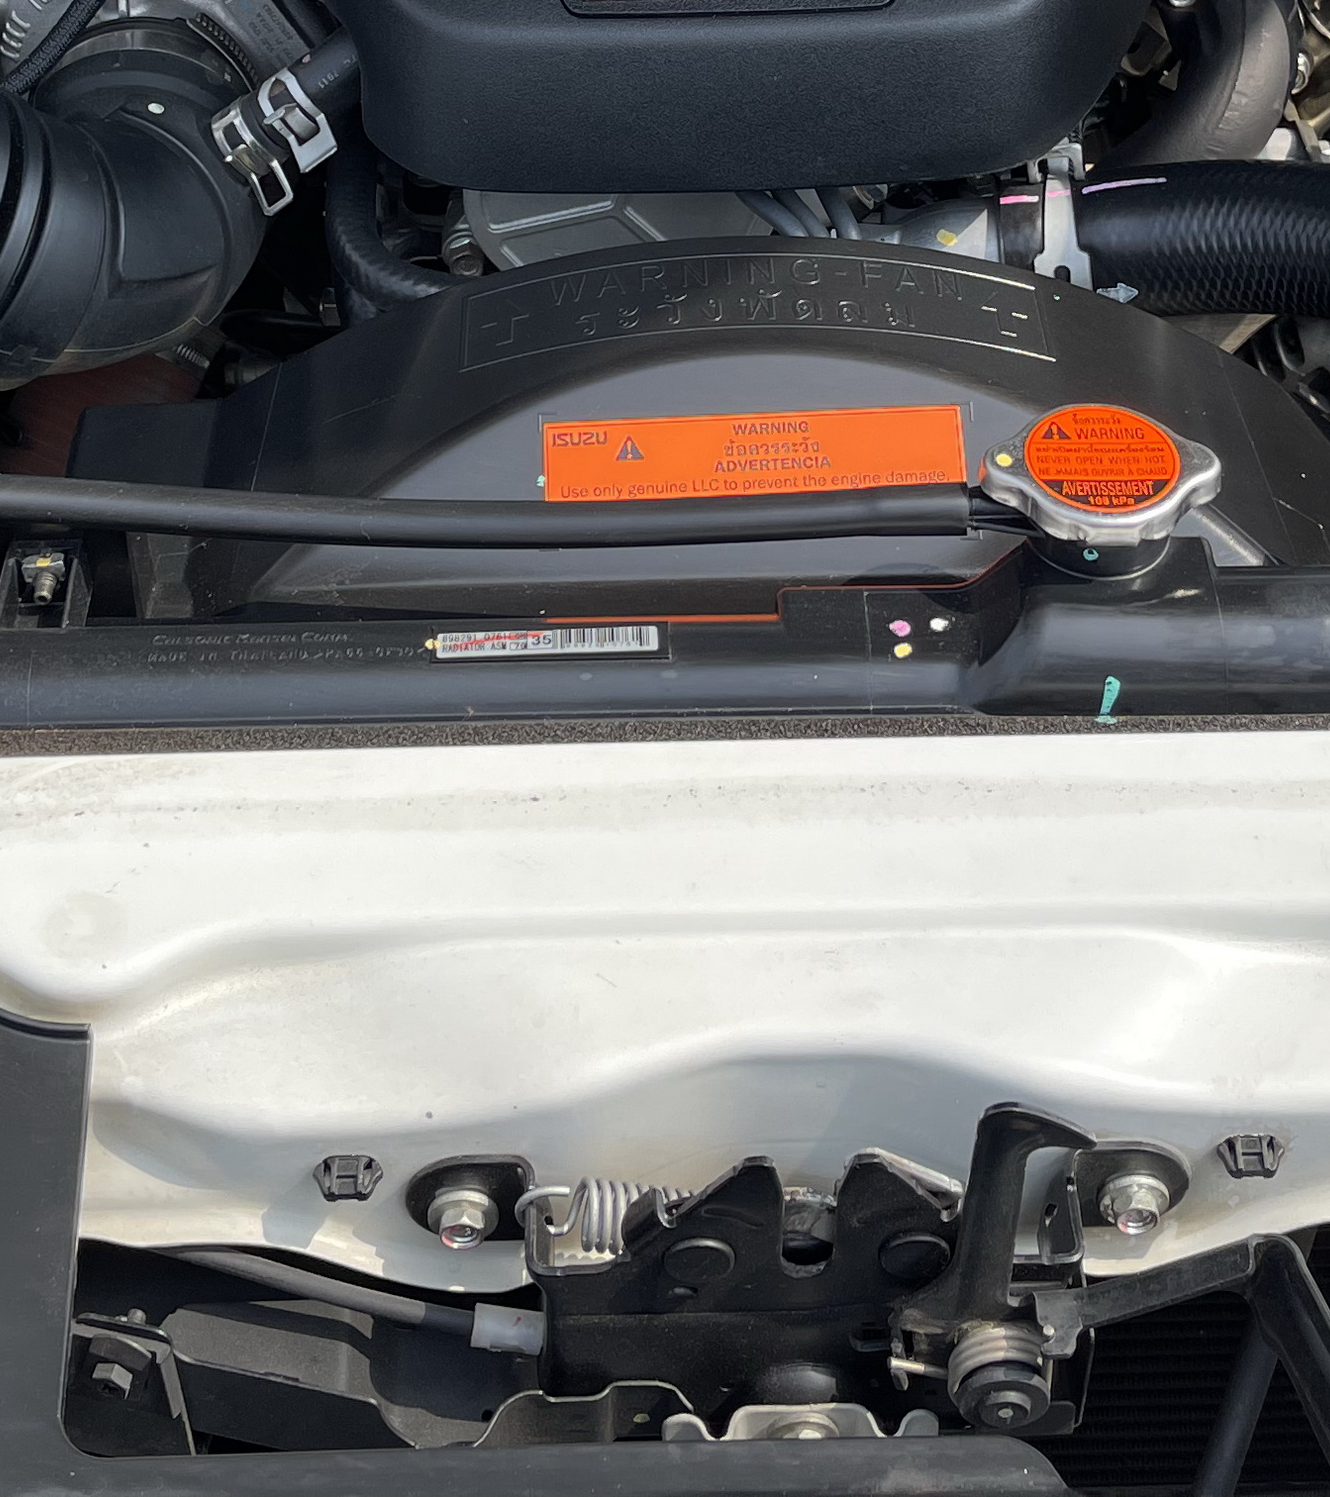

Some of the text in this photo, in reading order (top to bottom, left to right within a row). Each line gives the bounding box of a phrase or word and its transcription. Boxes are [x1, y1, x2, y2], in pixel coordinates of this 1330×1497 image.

[732, 420, 811, 436] WARNING
[1074, 427, 1145, 440] WARNING
[552, 430, 609, 448] ISUZU
[714, 455, 832, 473] ADVERTENCIA
[1036, 454, 1071, 463] NEVER
[1075, 455, 1103, 464] OPEN
[559, 484, 589, 499] Use
[593, 484, 624, 500] only
[627, 482, 688, 499] genuine
[692, 479, 720, 493] LLC
[723, 478, 739, 491] to
[742, 477, 799, 493] prevent
[802, 474, 827, 488] the
[830, 472, 882, 489] engine
[1062, 480, 1154, 496] AVERTISSEMENT
[530, 633, 553, 646] 35
